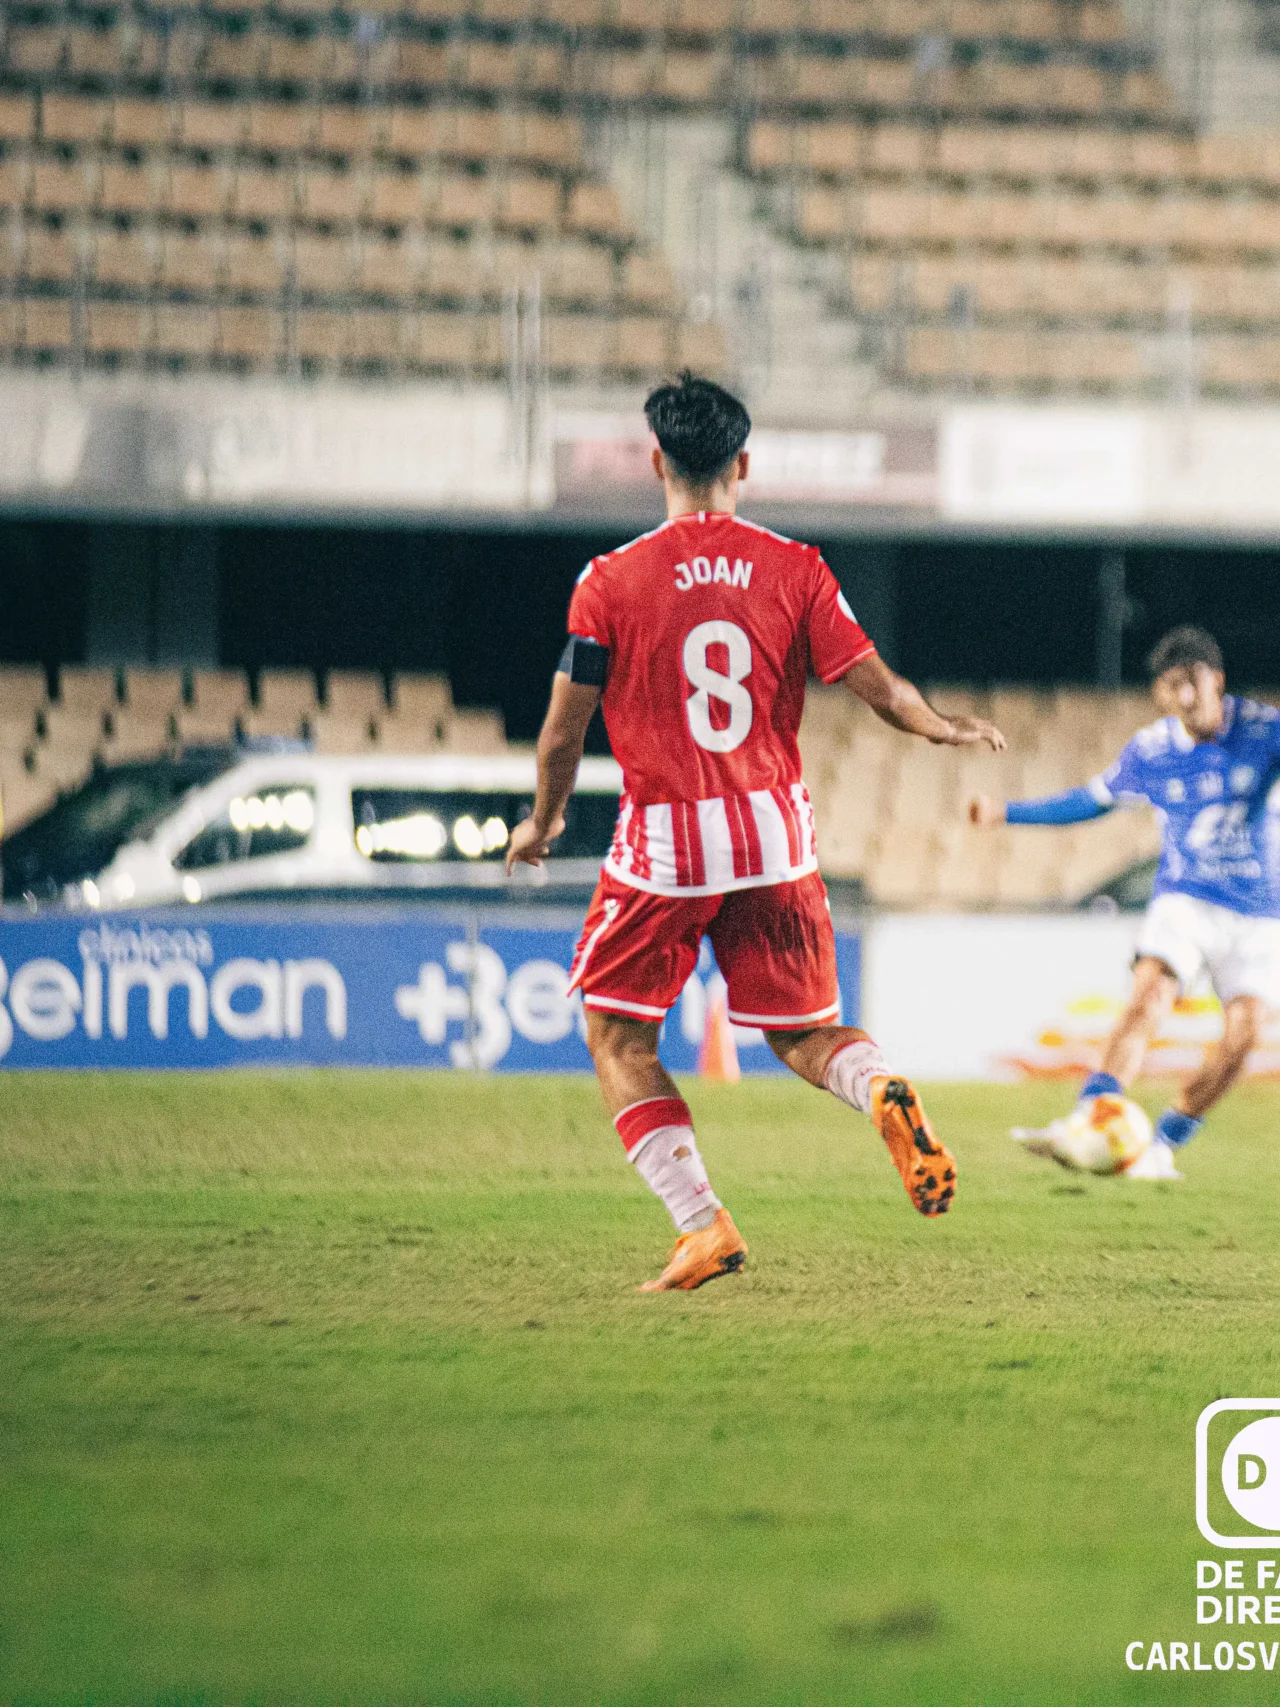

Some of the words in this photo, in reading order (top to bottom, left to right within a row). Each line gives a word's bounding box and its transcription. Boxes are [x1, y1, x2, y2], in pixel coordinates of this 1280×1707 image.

[674, 555, 754, 592] JOAN
[682, 618, 753, 754] 8
[0, 948, 348, 1062] elman
